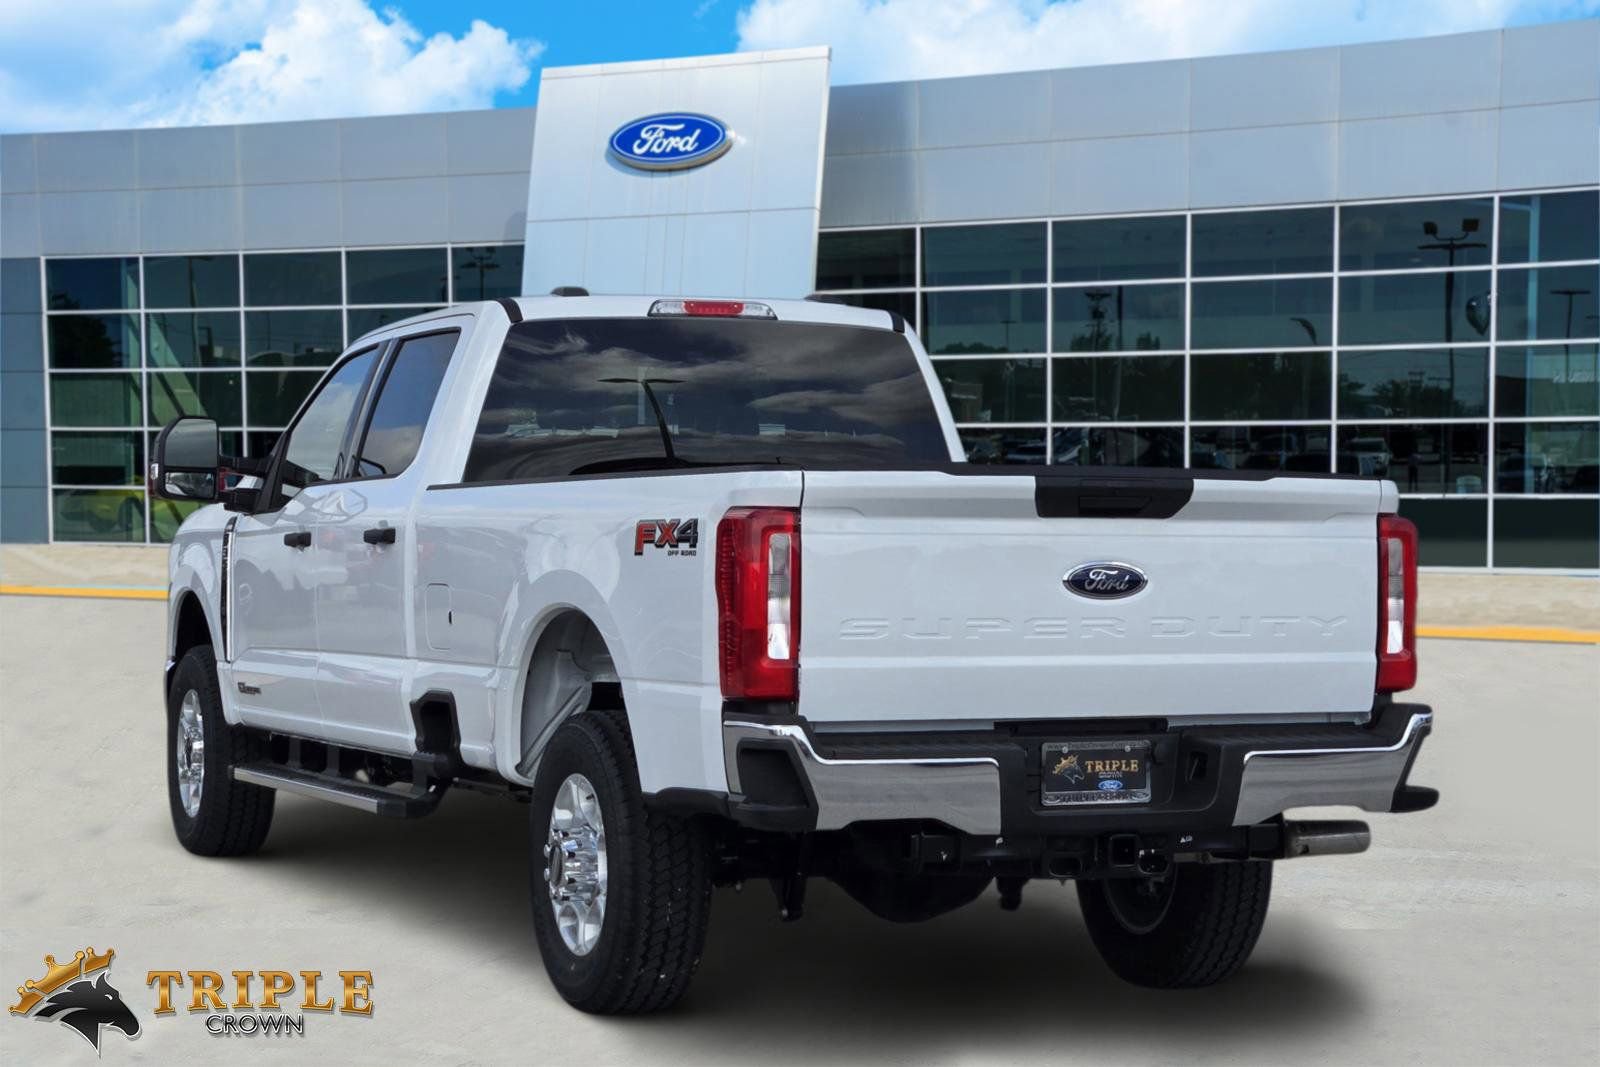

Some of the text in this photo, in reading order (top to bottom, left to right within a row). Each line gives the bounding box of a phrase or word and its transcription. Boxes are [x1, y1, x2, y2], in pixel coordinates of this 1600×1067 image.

[632, 123, 701, 155] Ford
[634, 518, 699, 556] FX4
[1084, 568, 1130, 591] Ford
[839, 615, 1348, 640] SUPER DUTY
[1084, 760, 1139, 773] TRIPLE
